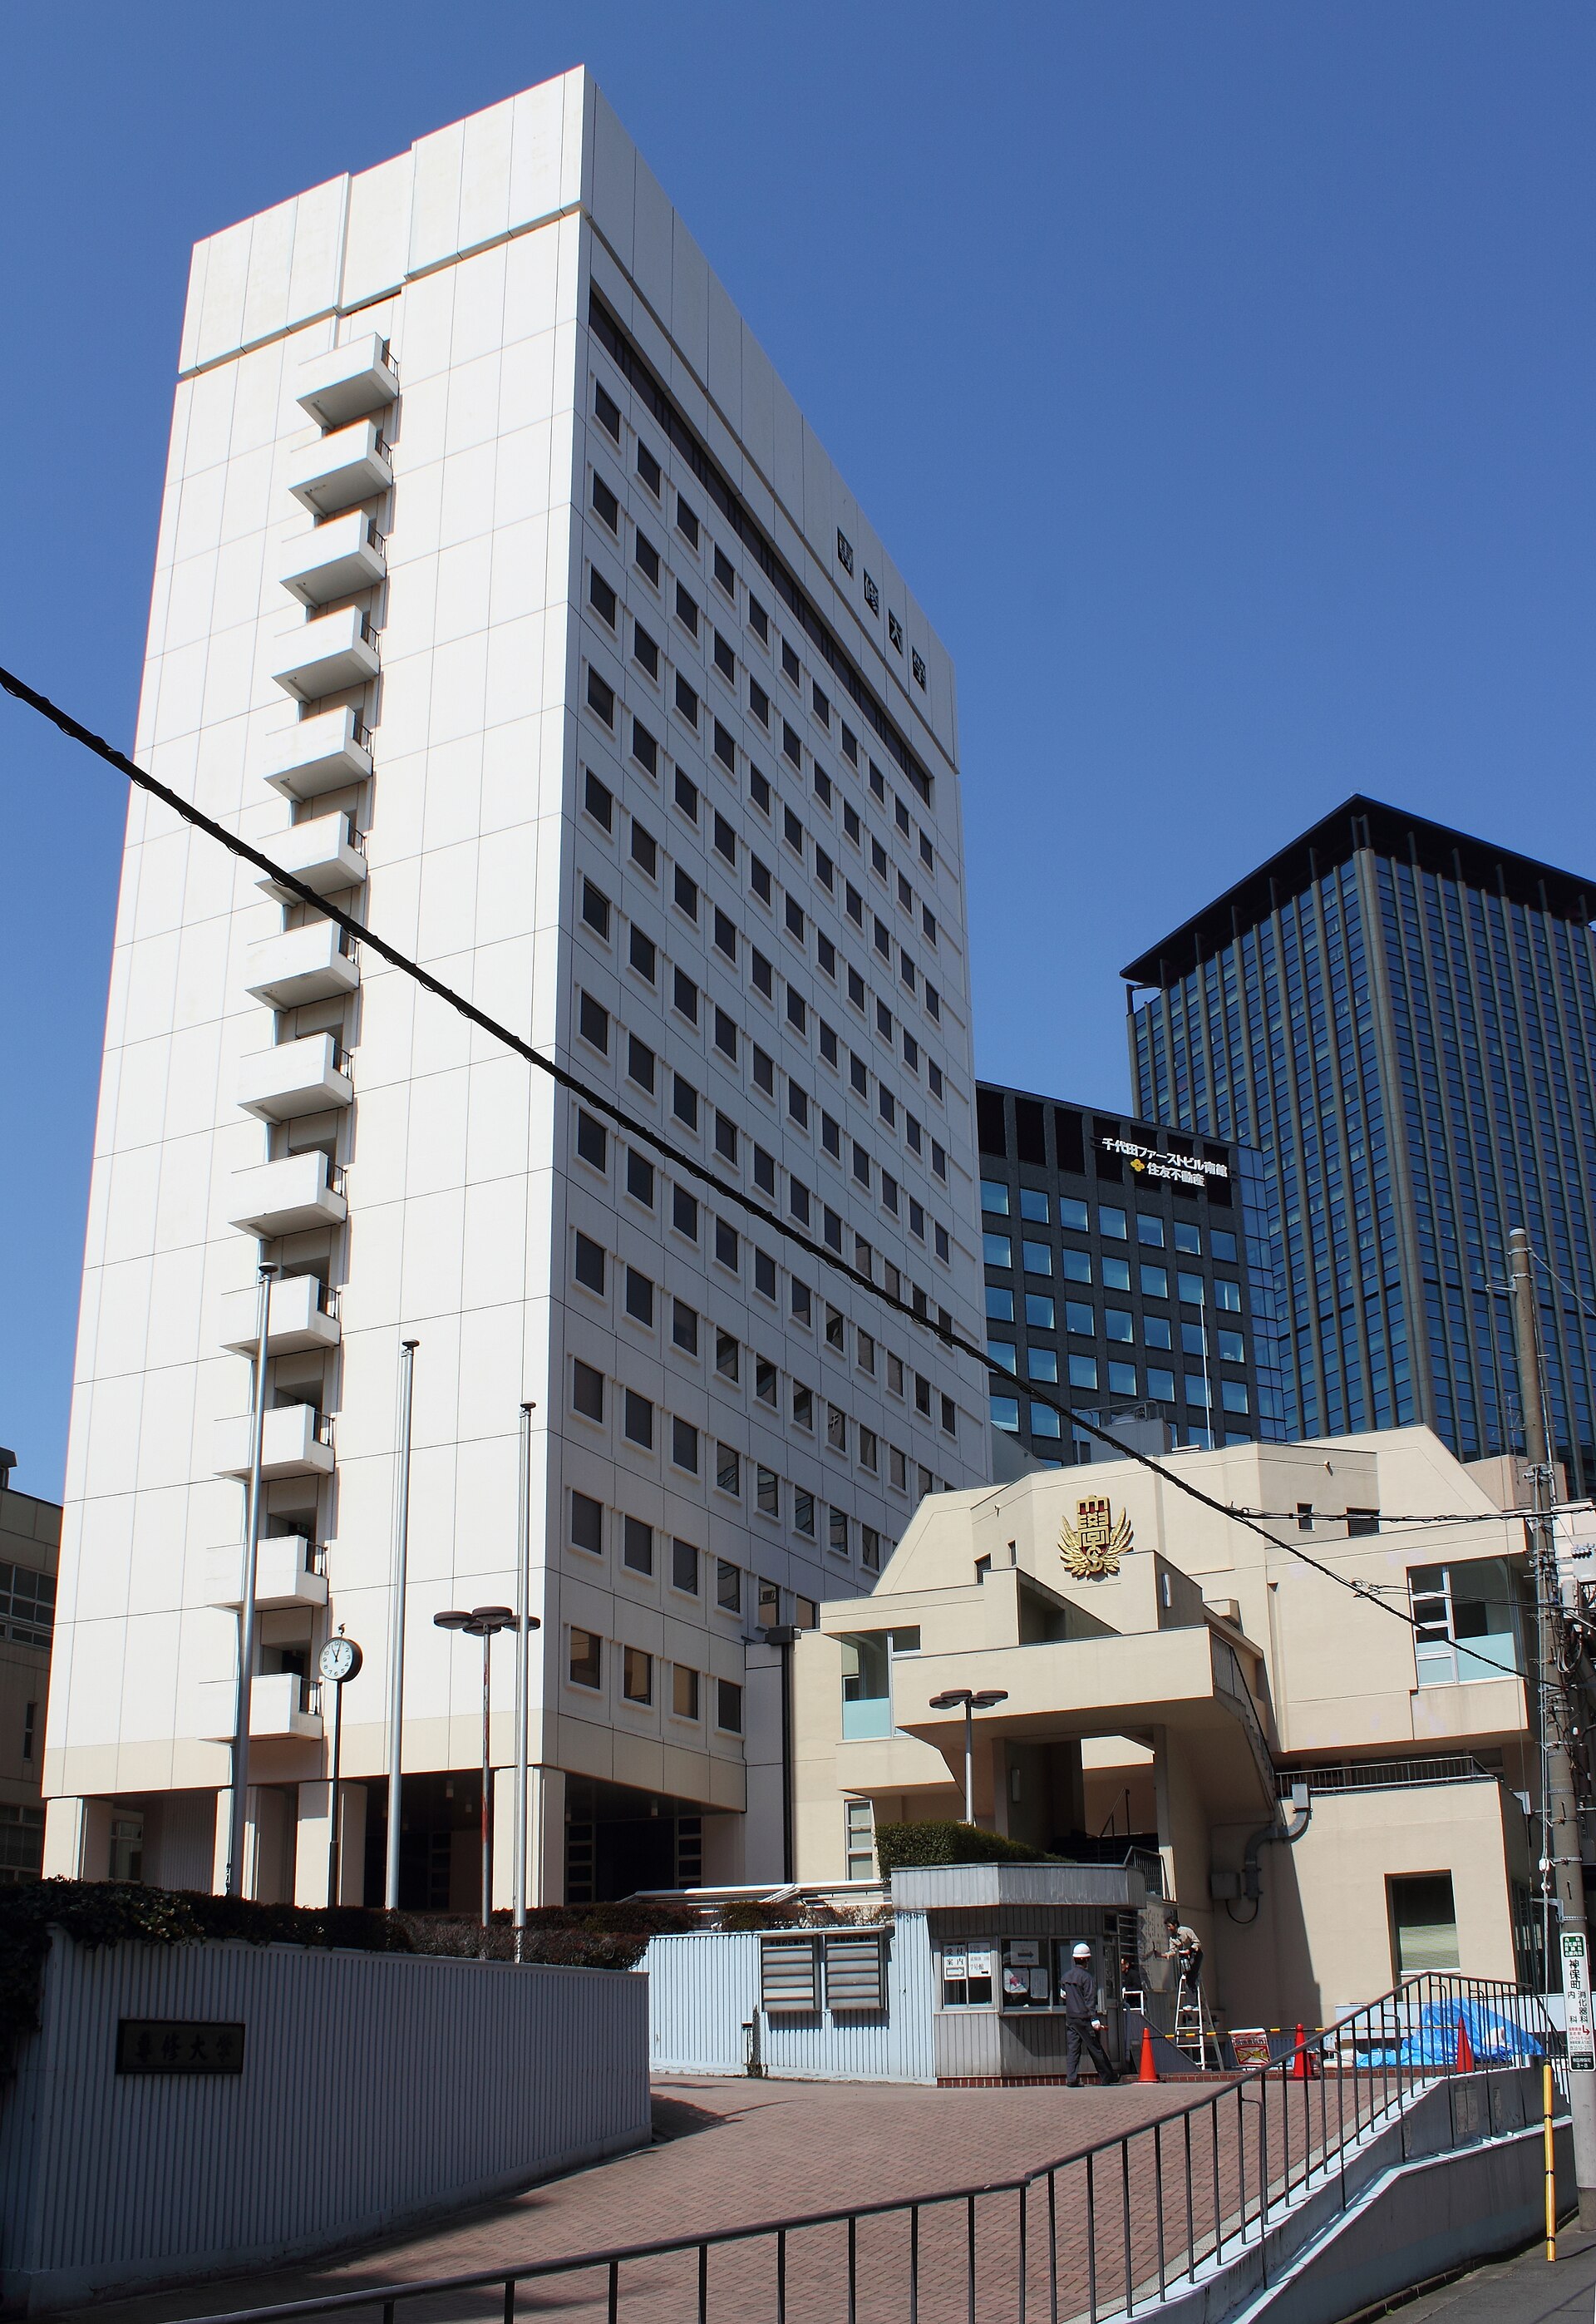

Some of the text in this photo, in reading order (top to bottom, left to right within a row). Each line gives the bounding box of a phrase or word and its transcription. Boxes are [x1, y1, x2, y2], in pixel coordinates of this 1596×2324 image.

[1101, 1137, 1229, 1177] 千代田ファーストビル南館
[1146, 1162, 1205, 1187] 住友不動産
[1569, 1959, 1580, 1990] 神保町
[1578, 1991, 1589, 2023] 消化器科
